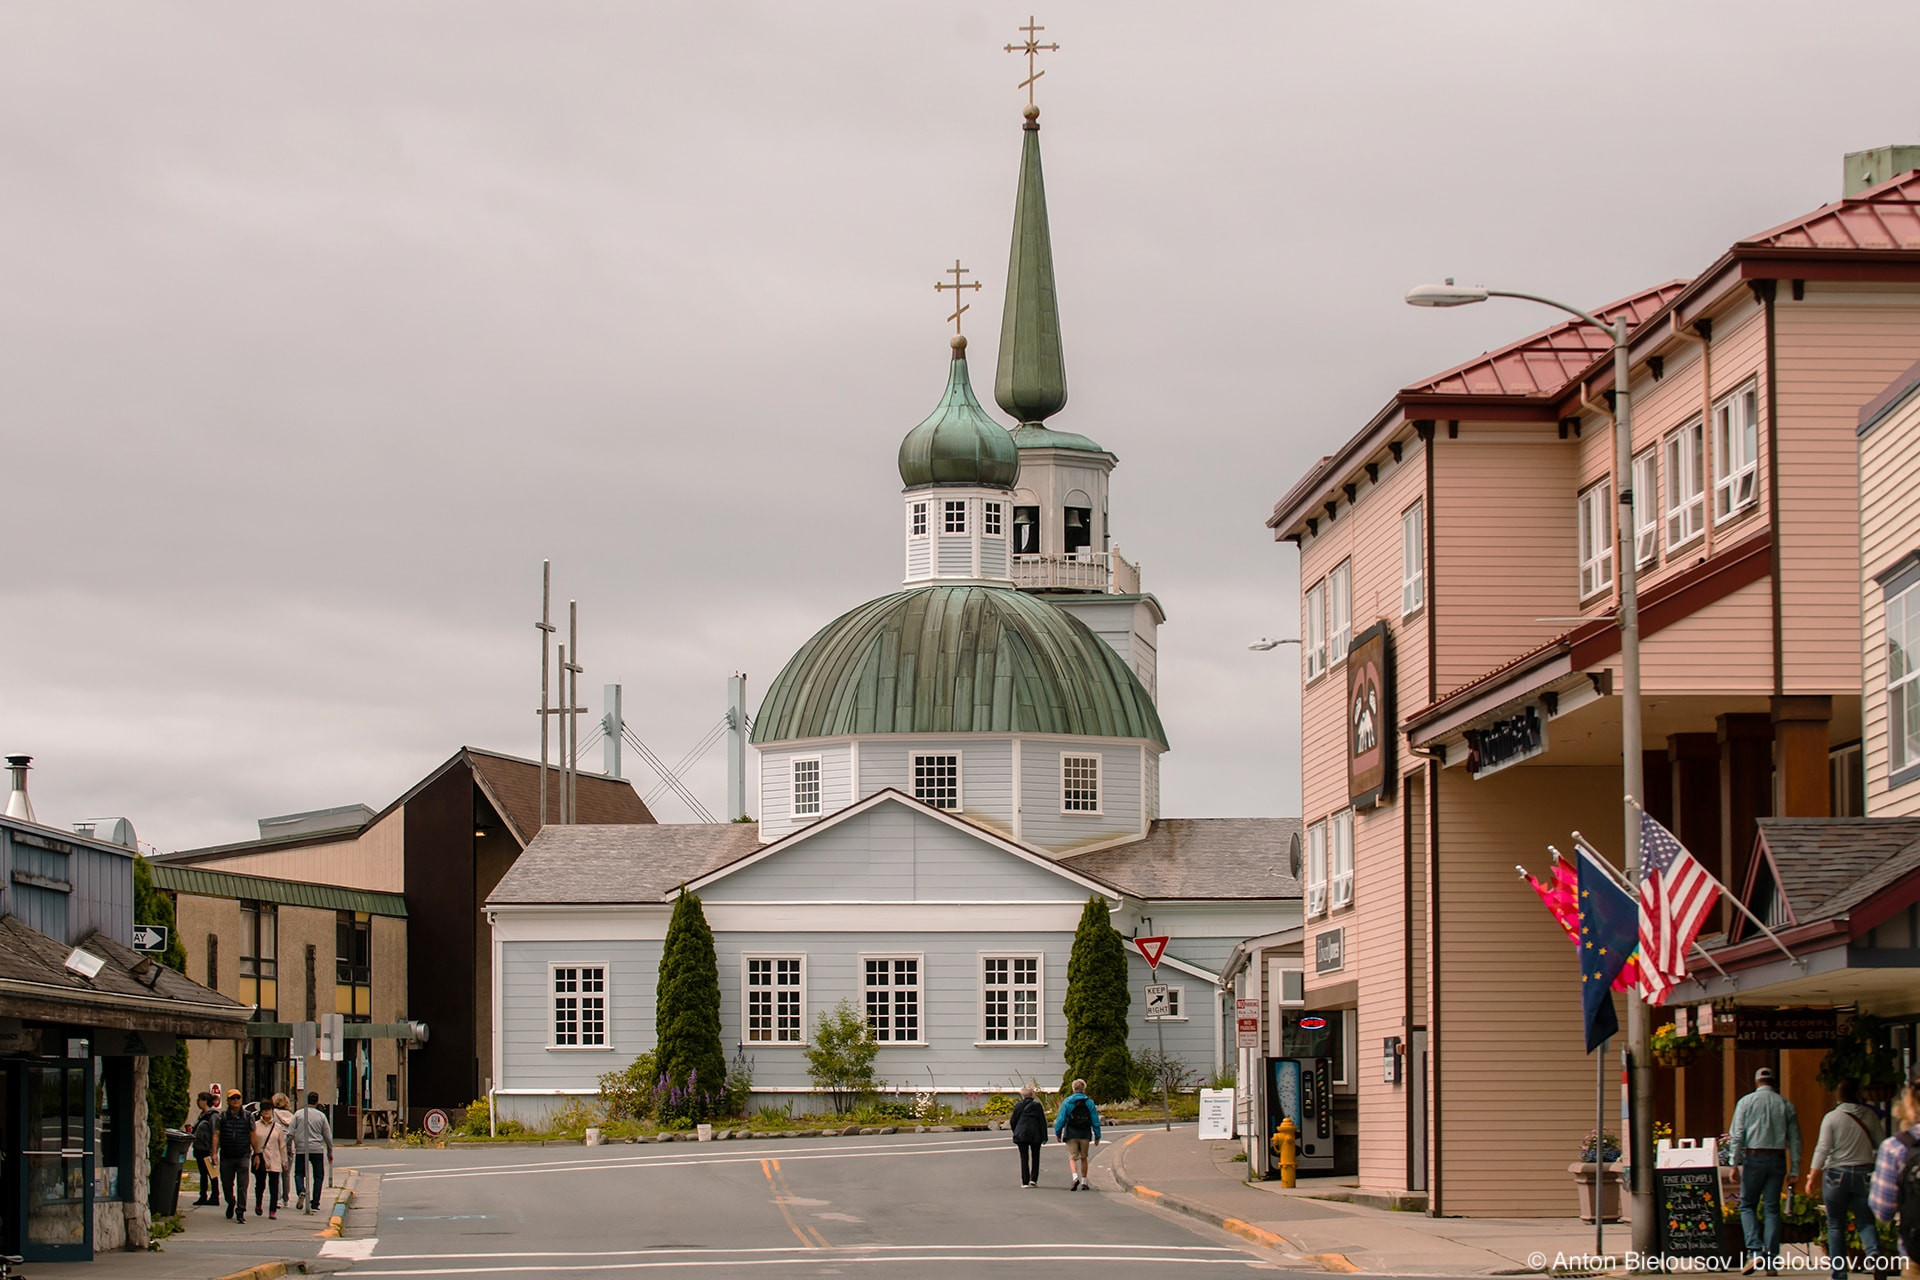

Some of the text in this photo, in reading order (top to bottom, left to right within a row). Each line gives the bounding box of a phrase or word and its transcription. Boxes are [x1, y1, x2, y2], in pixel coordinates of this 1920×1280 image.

[1147, 986, 1166, 995] KEEP
[1147, 1006, 1168, 1014] RIGHT
[1739, 1020, 1769, 1028] FATE
[1737, 1030, 1837, 1041] ART LOCAL GIFTS
[1662, 1175, 1680, 1184] FATE
